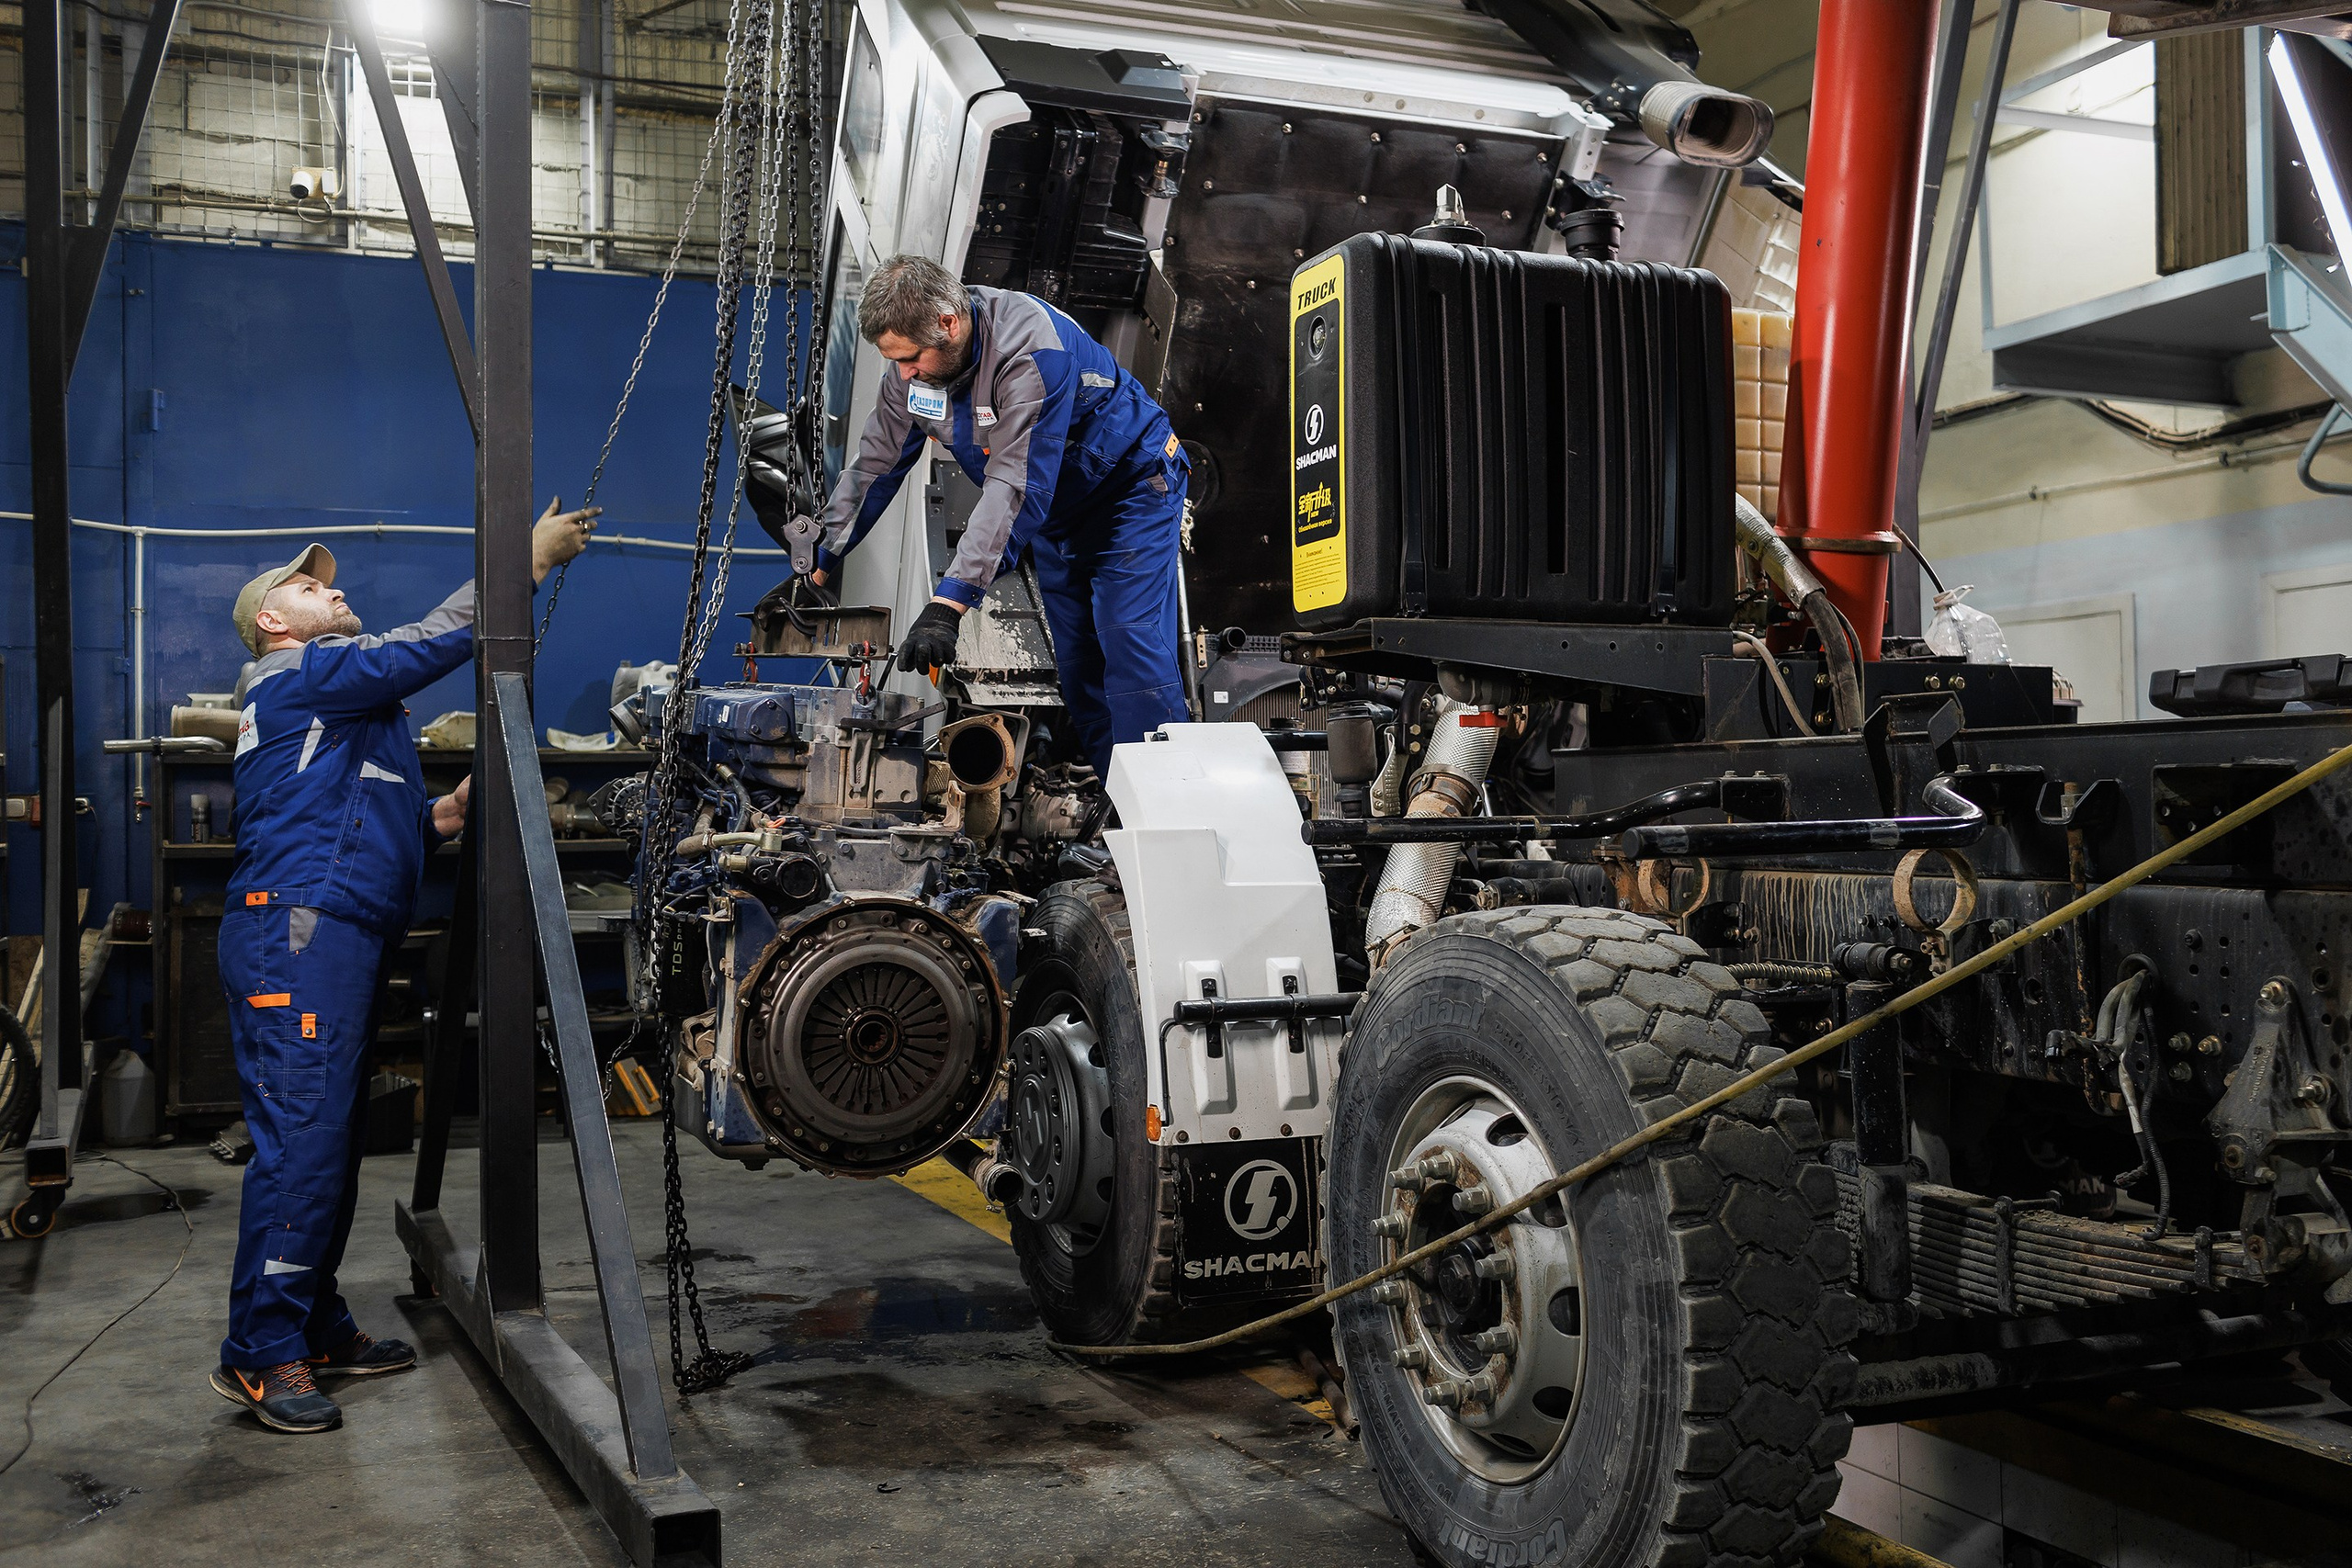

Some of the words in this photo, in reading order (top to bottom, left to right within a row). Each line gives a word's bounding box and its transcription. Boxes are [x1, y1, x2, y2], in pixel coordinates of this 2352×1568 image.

[1297, 276, 1337, 310] TRUCK
[916, 396, 944, 410] ГАЗПРОМ
[1295, 444, 1337, 470] SHACMAN
[1374, 991, 1487, 1071] Cordiant
[1437, 1514, 1568, 1568] Cordiant
